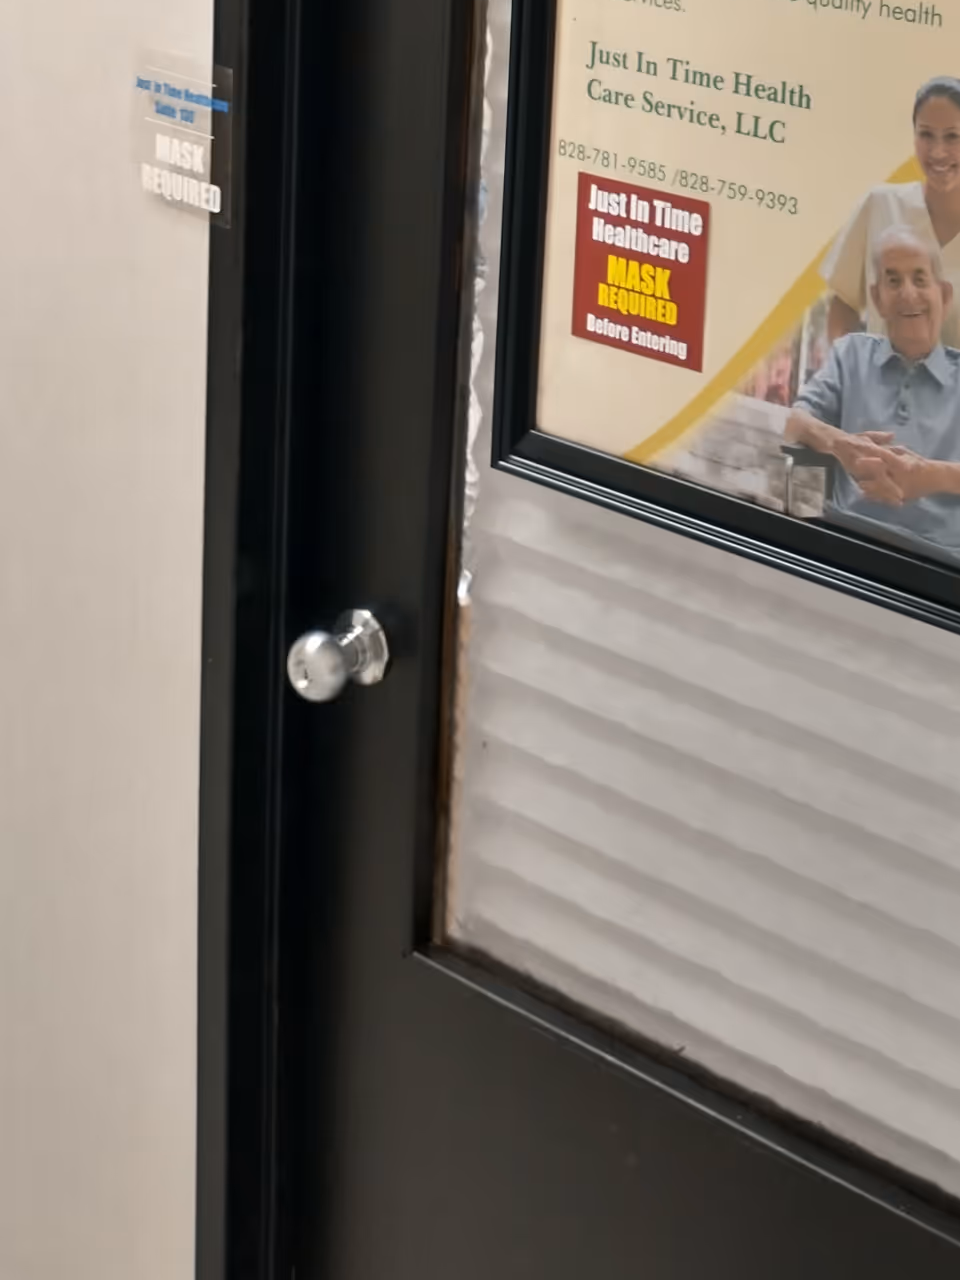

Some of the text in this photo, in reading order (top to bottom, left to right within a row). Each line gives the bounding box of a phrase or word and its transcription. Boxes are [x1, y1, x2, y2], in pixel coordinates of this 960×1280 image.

[586, 41, 811, 110] Just In Time Health
[587, 78, 786, 143] Care Service, LLC
[558, 139, 666, 181] 828-781-9585
[588, 184, 703, 237] Just In Time
[592, 216, 690, 264] Healthcare
[607, 254, 671, 300] MASK
[598, 282, 677, 326] REQUIRED
[586, 312, 687, 360] Before Entering
